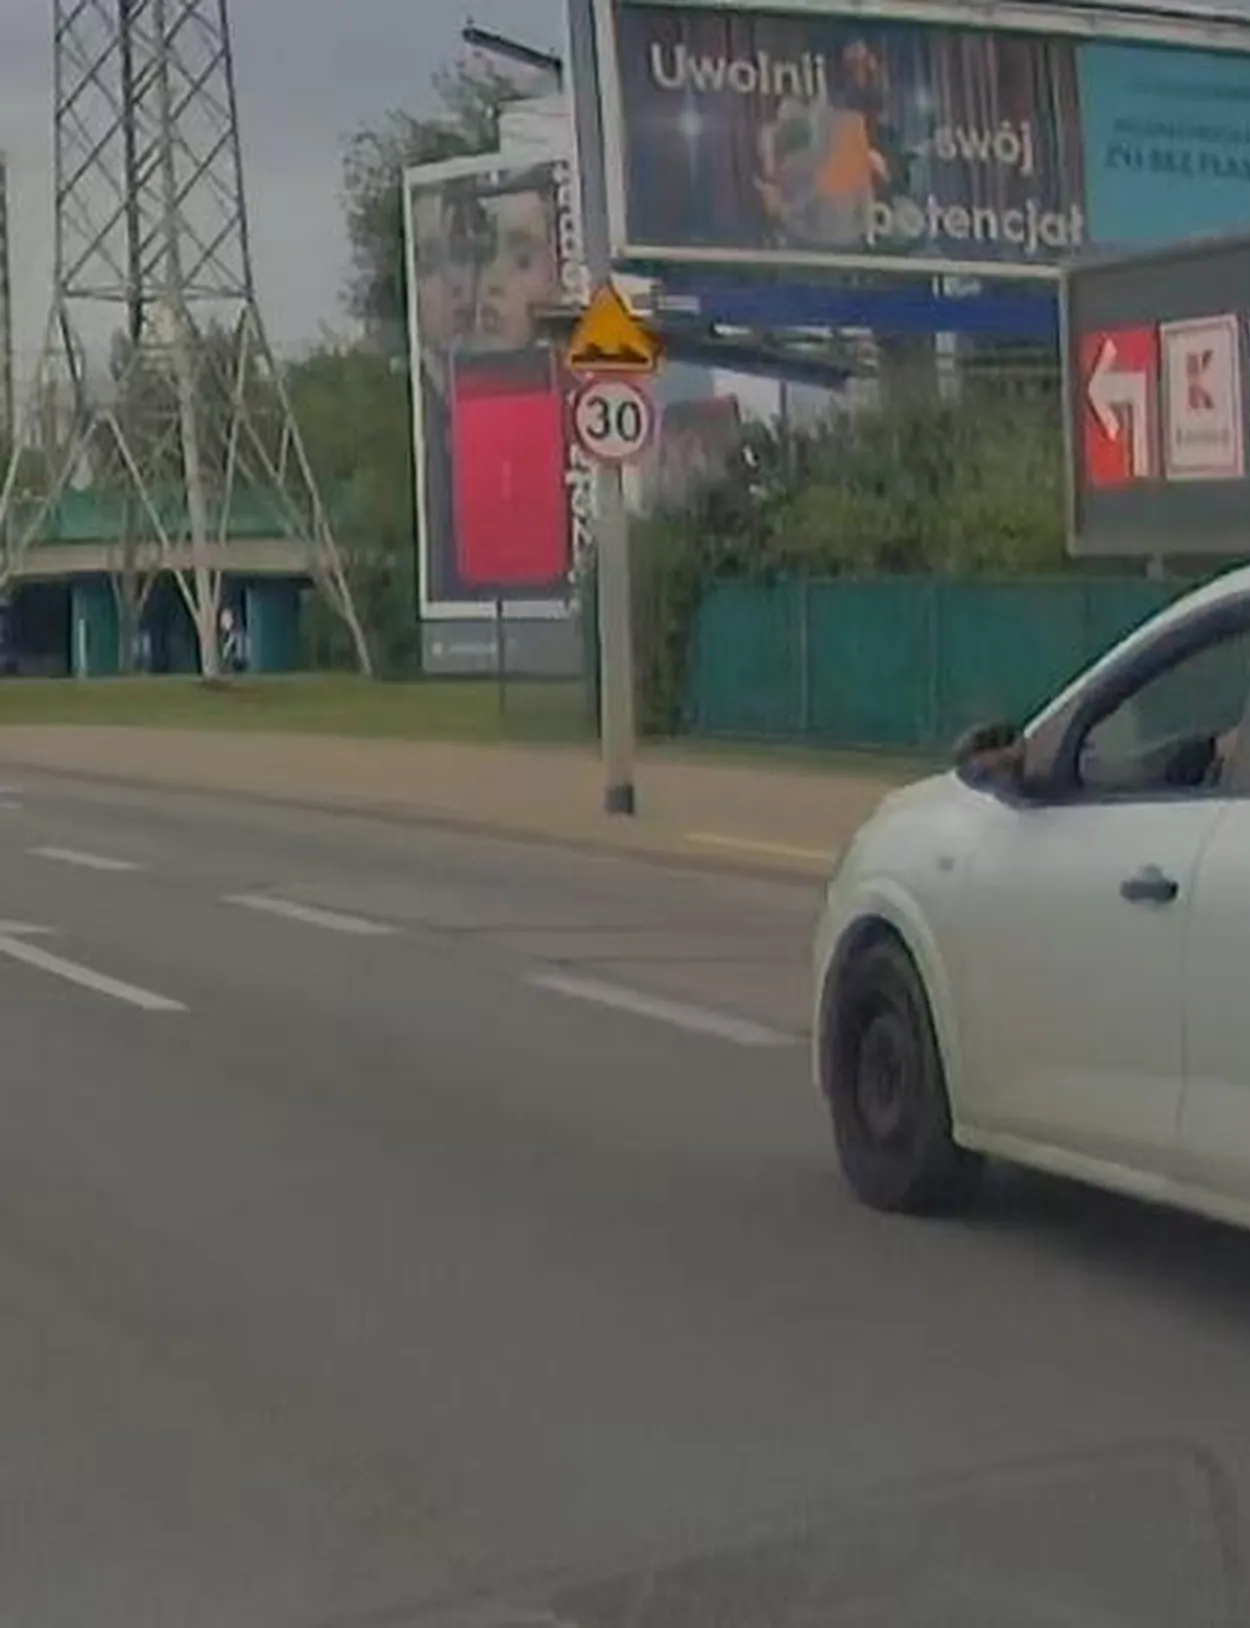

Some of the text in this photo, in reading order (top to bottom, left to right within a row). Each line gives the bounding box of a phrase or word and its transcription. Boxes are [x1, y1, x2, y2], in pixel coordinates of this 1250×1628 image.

[649, 41, 827, 98] Uwolnij
[935, 119, 1034, 175] swój
[866, 194, 1085, 254] potencjał
[586, 395, 642, 443] 30
